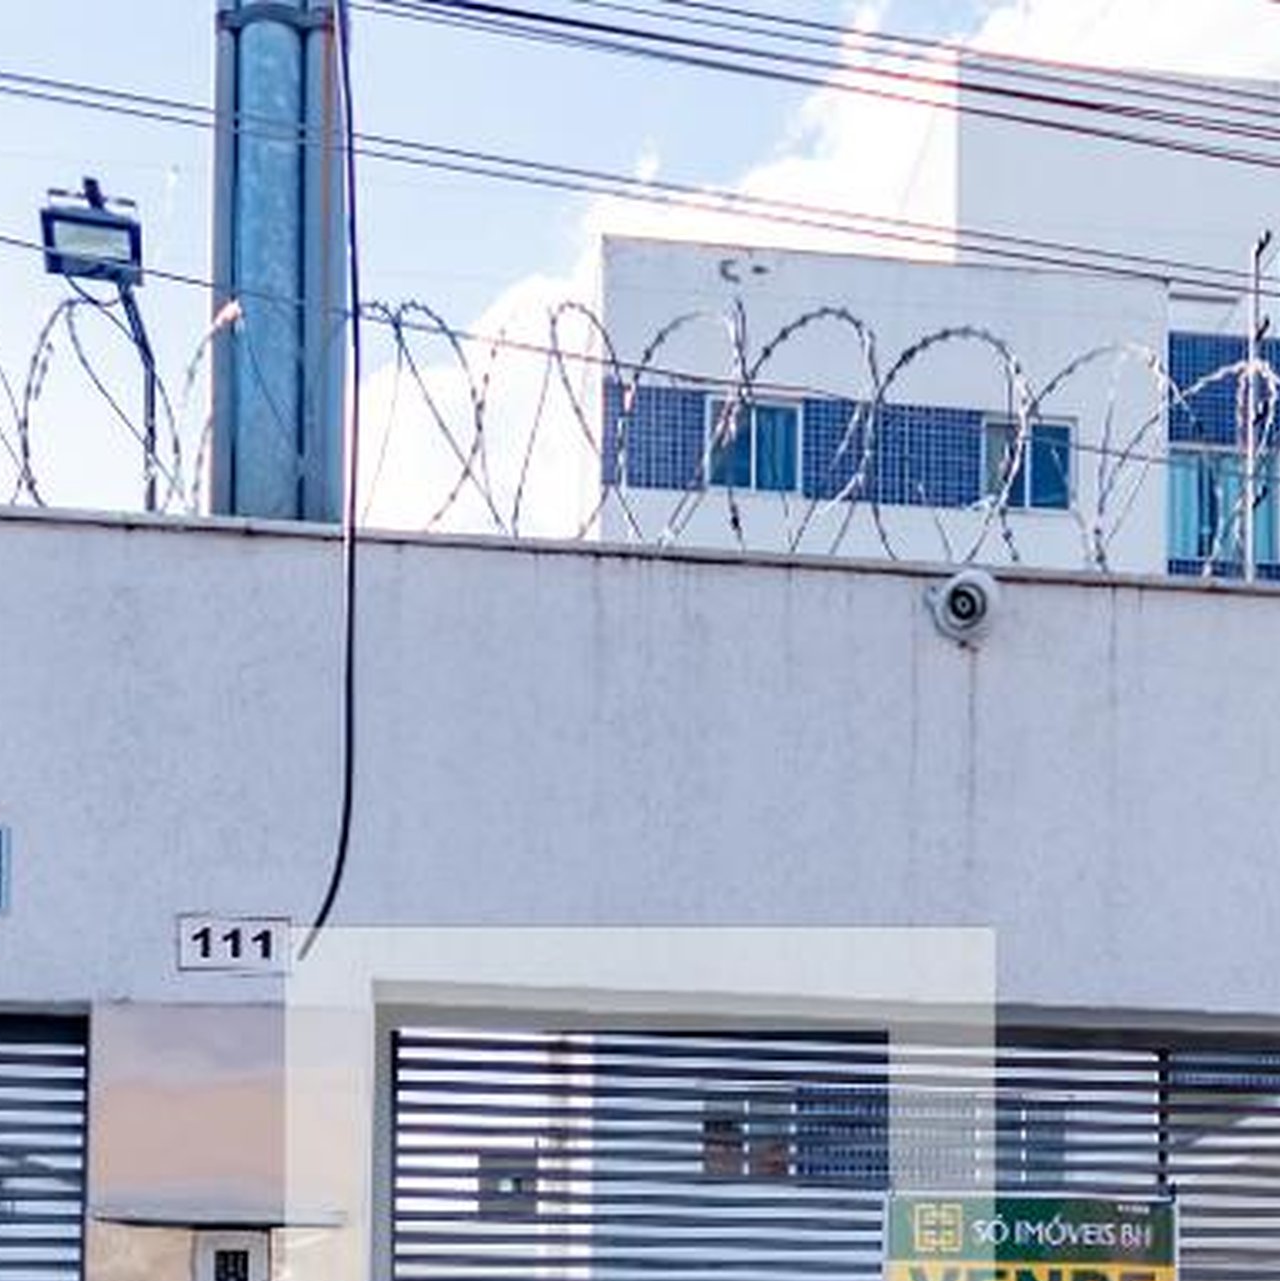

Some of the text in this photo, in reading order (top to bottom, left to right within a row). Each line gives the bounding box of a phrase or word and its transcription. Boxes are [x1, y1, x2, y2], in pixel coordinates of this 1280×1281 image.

[192, 926, 272, 959] 111
[971, 1214, 1152, 1248] SÓ IMÓVEIS BH
